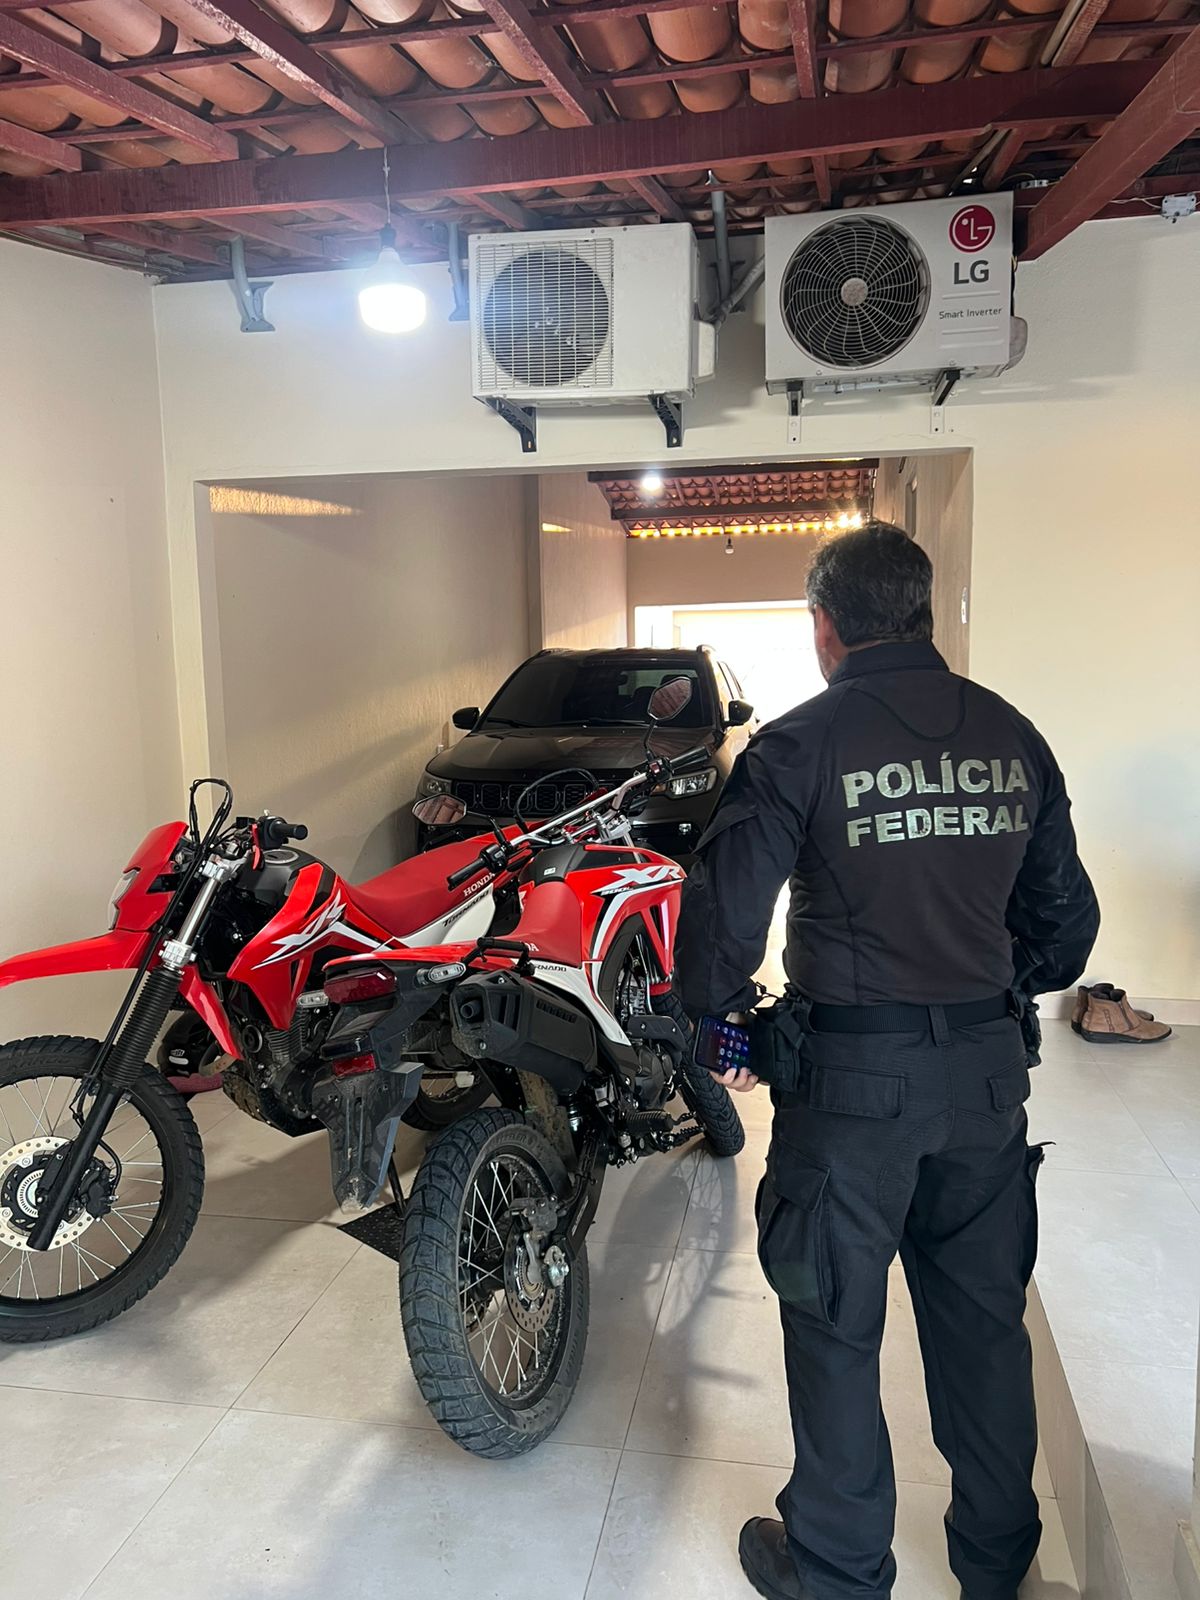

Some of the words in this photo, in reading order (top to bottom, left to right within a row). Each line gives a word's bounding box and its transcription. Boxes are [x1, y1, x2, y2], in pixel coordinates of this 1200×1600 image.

[953, 260, 990, 285] LG
[939, 310, 964, 320] Smart
[966, 307, 1002, 317] Inverter
[842, 752, 1029, 808] POLÍCIA
[847, 804, 1029, 848] FEDERAL
[590, 865, 682, 894] XR
[536, 964, 567, 972] RNADO
